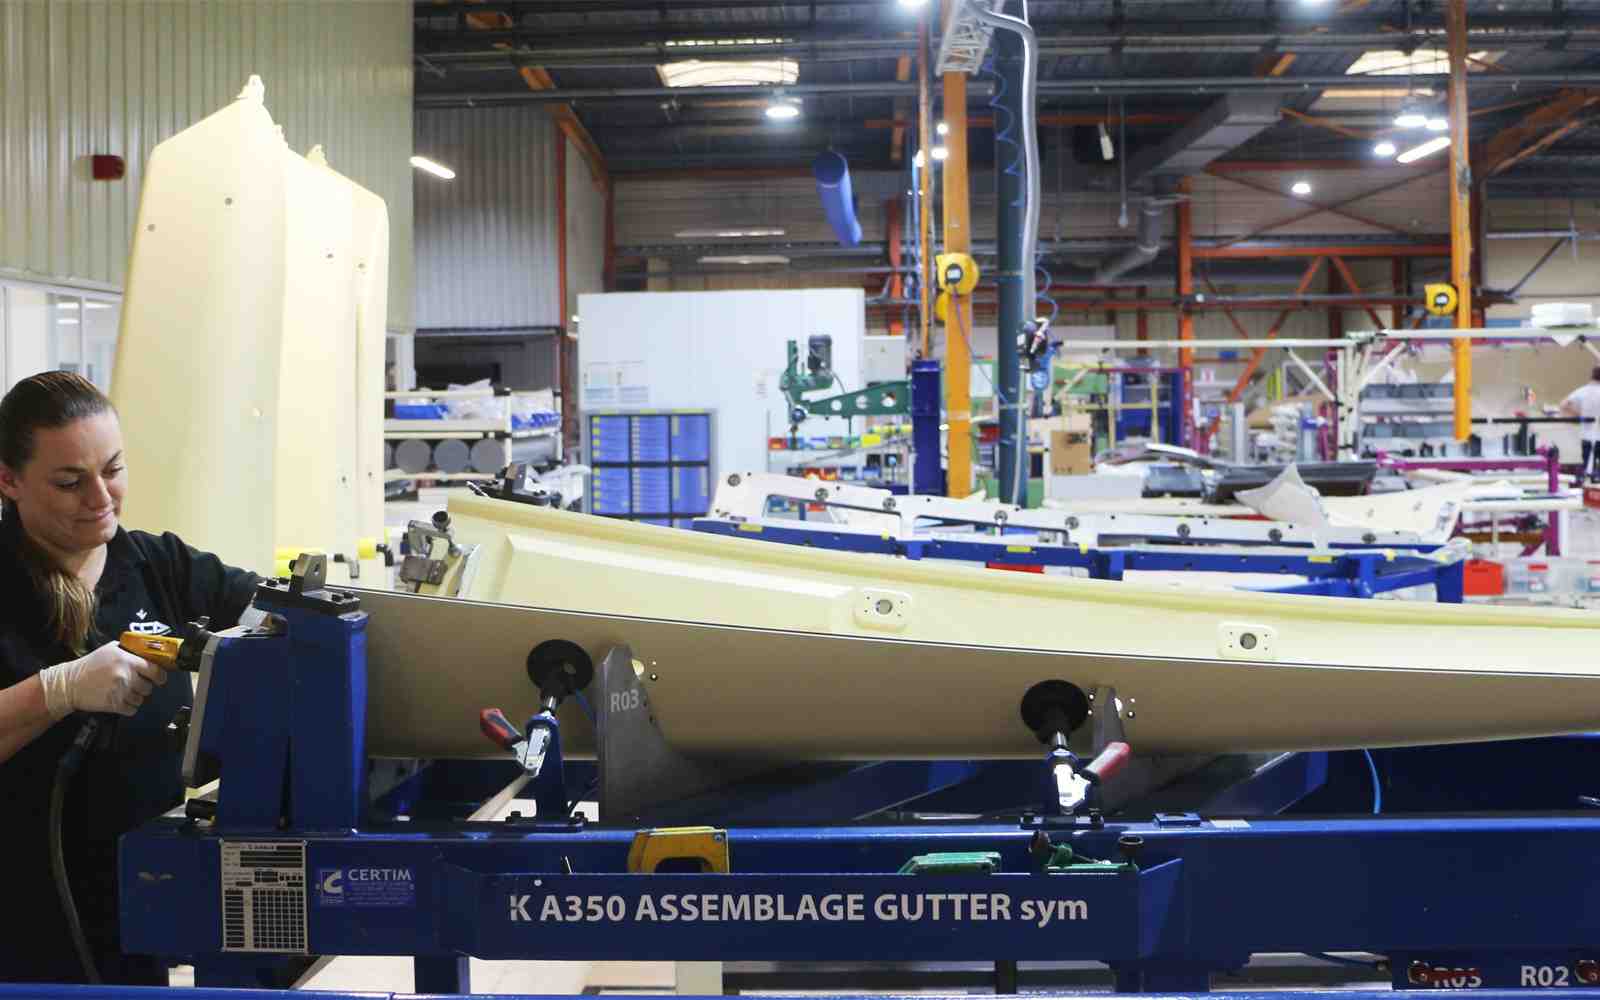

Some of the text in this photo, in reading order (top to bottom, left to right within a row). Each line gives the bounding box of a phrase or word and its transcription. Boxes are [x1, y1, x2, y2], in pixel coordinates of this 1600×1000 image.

[610, 689, 640, 713] R03
[348, 868, 411, 881] CERTIM
[509, 894, 1088, 929] K A350 ASSEMBLAGE GUTTER sym
[1520, 965, 1569, 987] R02
